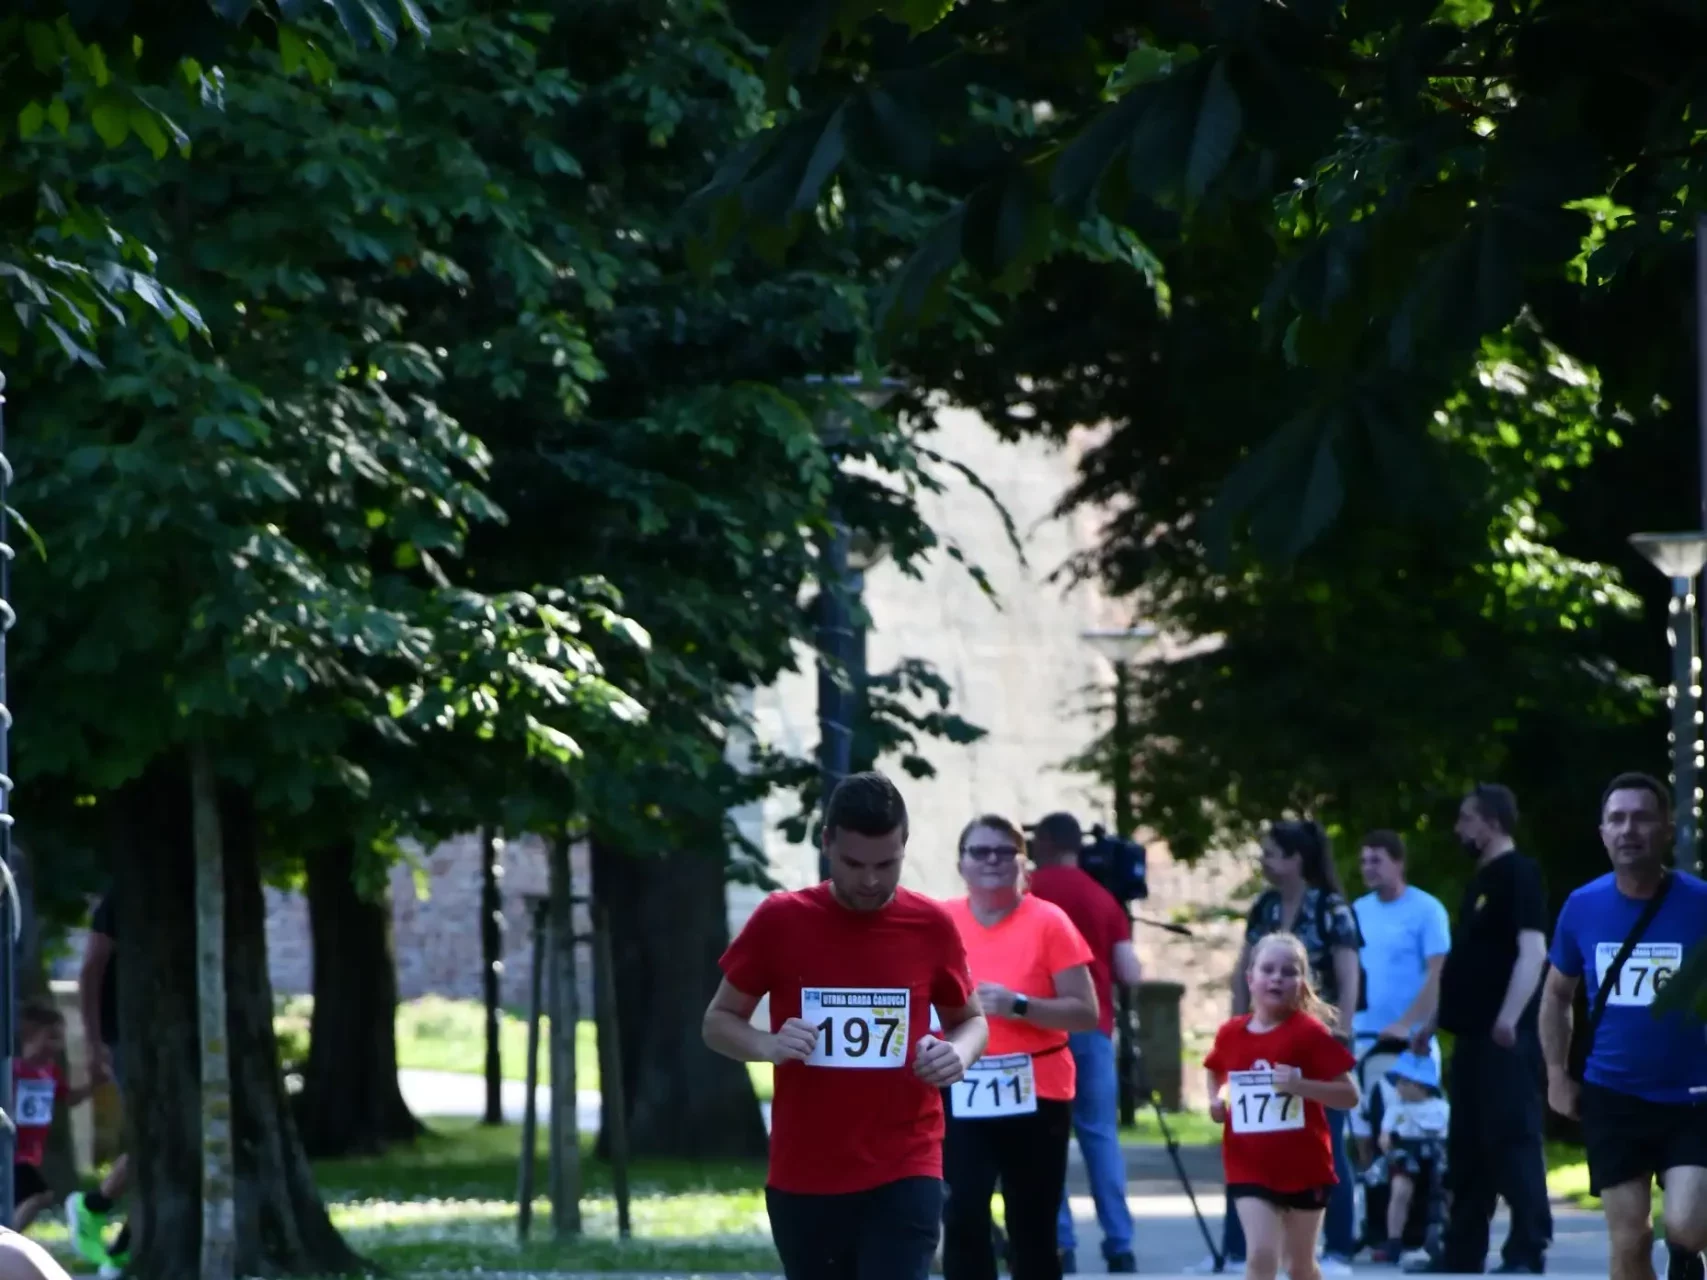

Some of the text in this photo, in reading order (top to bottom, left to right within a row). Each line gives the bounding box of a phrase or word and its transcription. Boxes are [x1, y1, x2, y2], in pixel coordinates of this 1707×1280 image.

[817, 1016, 900, 1057] 197
[962, 1075, 1022, 1108] 711
[1238, 1092, 1294, 1124] 177
